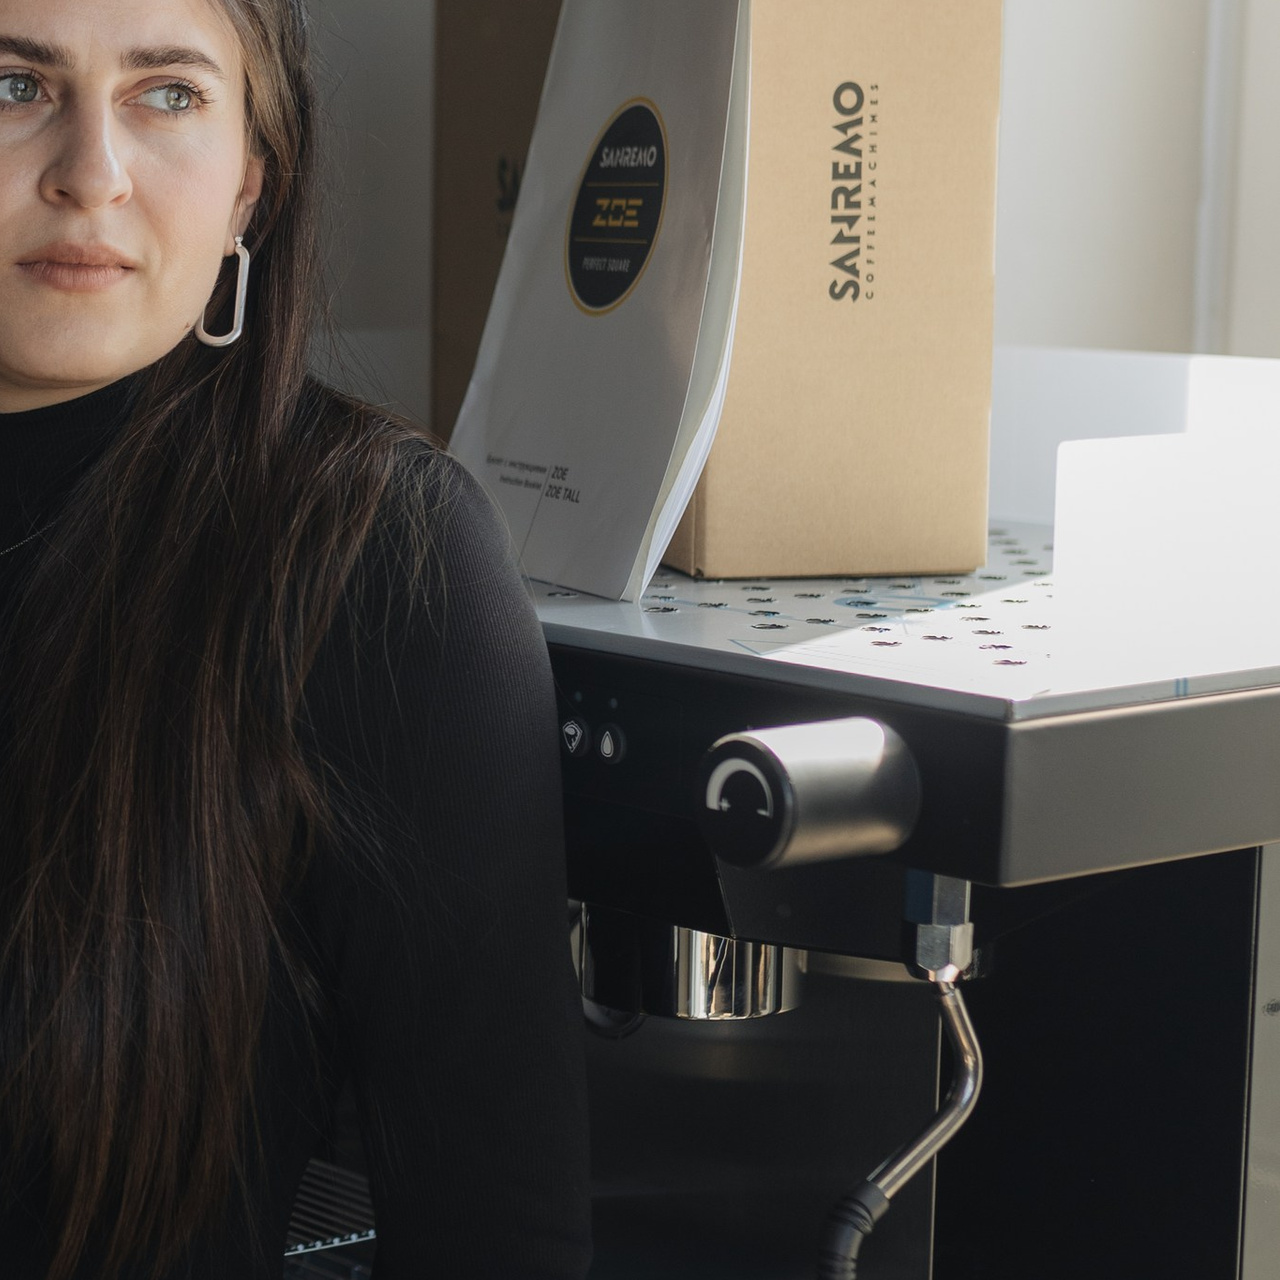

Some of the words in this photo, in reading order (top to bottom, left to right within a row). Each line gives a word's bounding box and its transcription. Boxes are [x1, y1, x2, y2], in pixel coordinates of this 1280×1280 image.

[599, 145, 657, 168] SANREMO
[829, 81, 864, 303] SANREMO
[592, 198, 643, 227] ZOE
[551, 465, 569, 481] ZOE
[545, 484, 562, 500] ZOE
[563, 487, 580, 503] TALL
